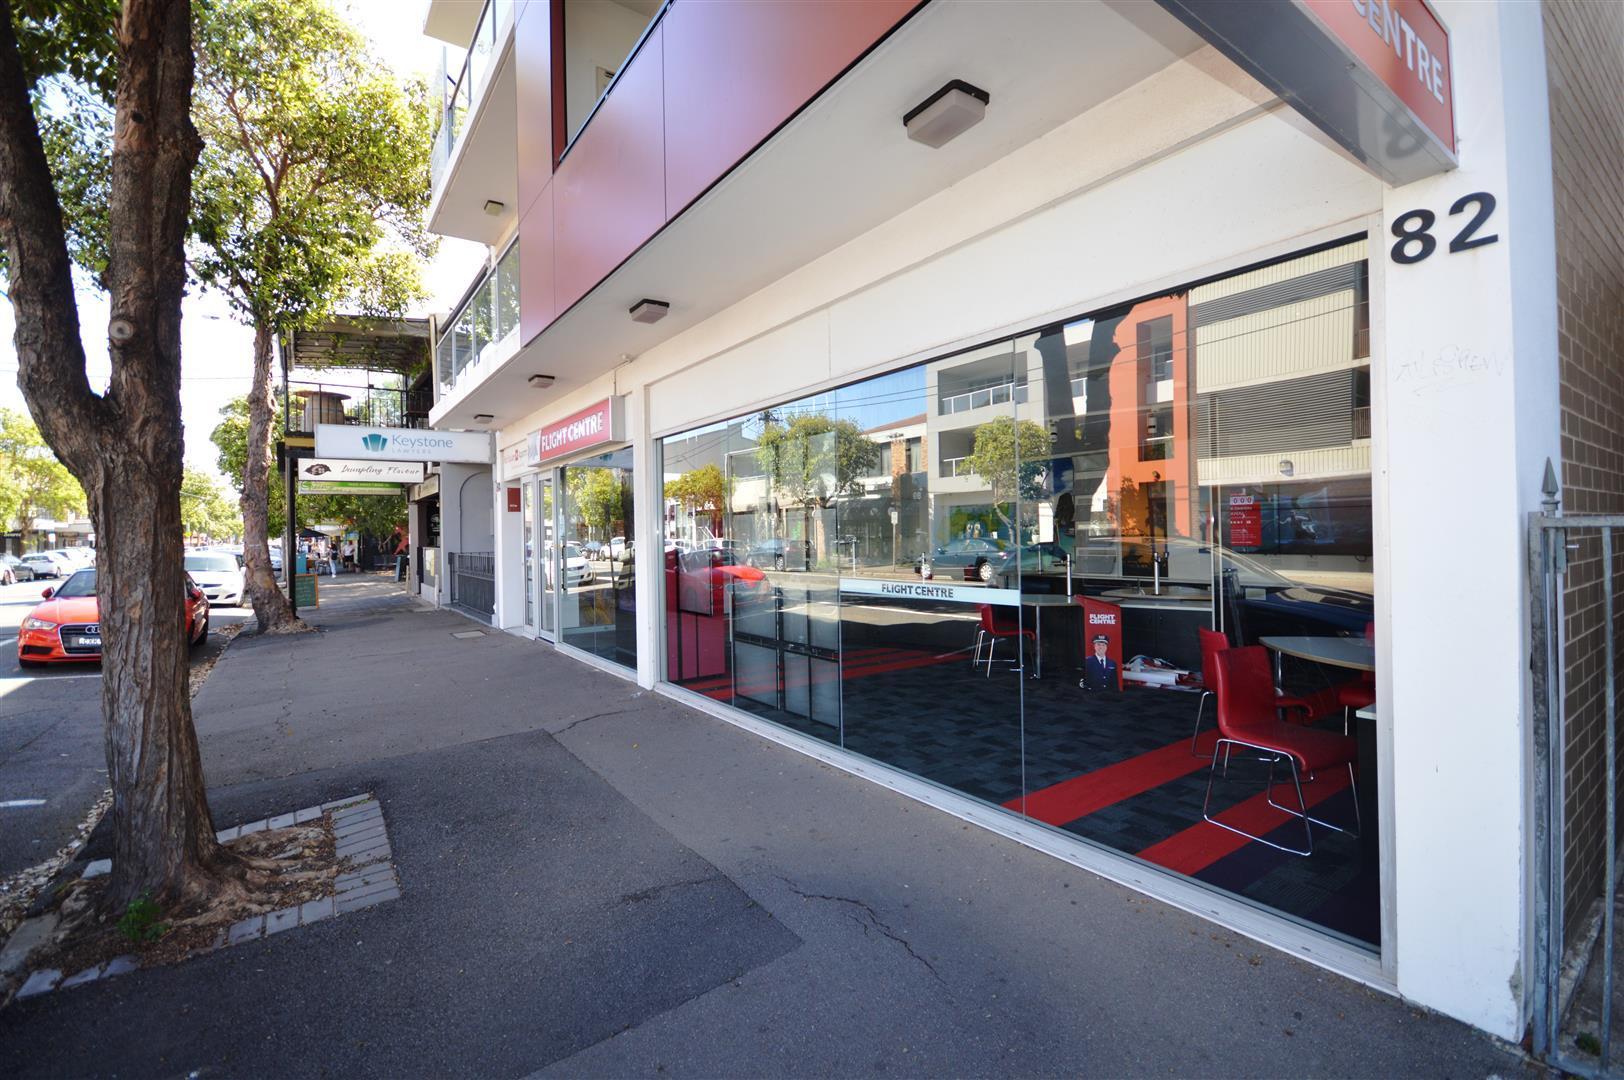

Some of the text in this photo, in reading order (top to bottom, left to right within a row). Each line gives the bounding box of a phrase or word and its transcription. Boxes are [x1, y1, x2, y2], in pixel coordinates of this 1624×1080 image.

[1390, 191, 1498, 264] 82
[392, 434, 453, 449] Keystone
[541, 412, 603, 452] FLIGHT CENTRE
[881, 583, 954, 598] FLIGHT CENTRE
